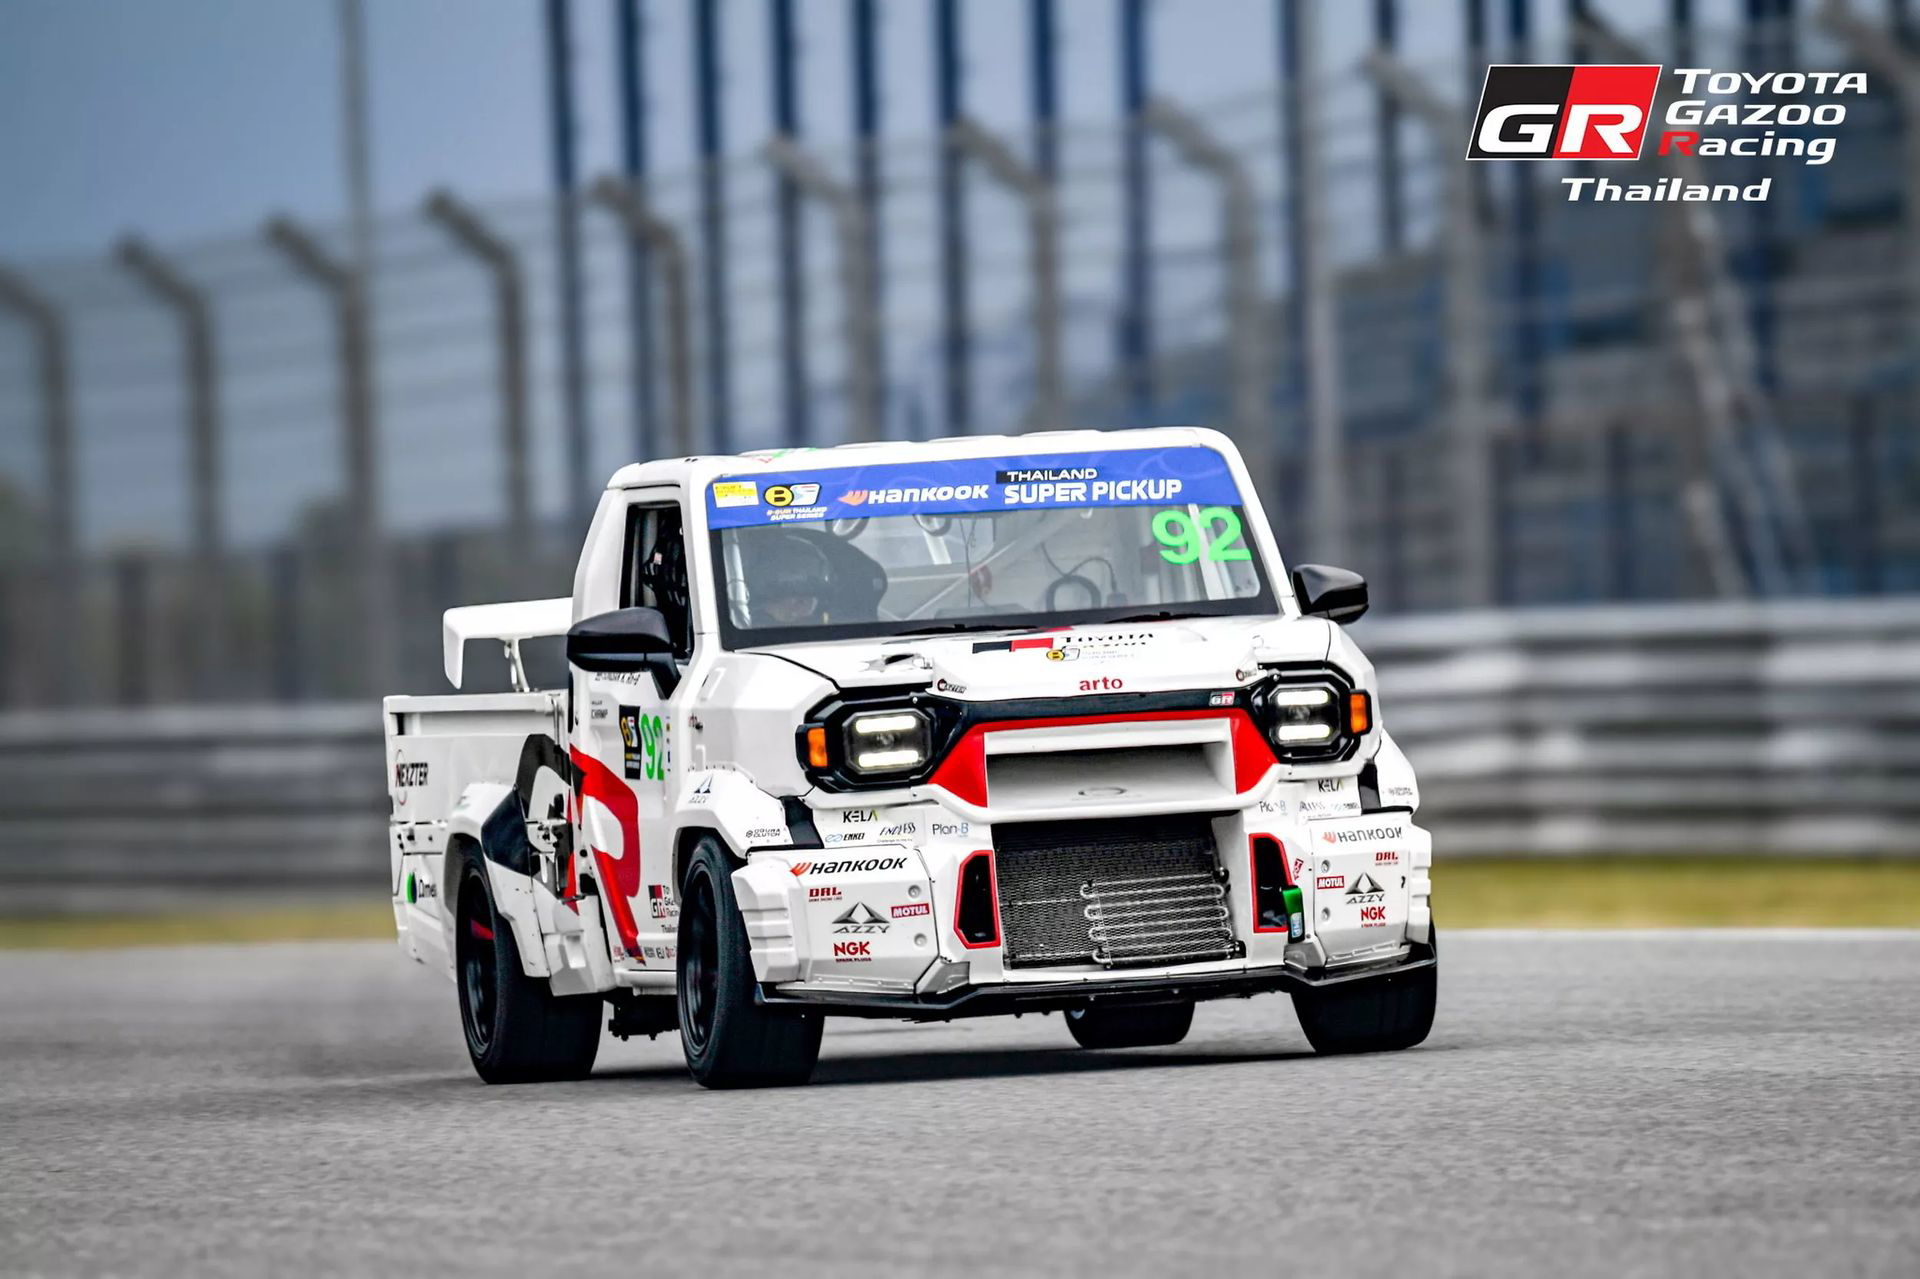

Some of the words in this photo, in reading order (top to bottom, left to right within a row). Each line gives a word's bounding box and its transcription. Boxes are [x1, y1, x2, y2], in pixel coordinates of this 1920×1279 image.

[1007, 467, 1098, 482] THAILAND
[1004, 482, 1087, 504] SUPER
[1092, 479, 1182, 501] PICKUP
[1152, 506, 1252, 565] 92
[1079, 676, 1123, 691] arto
[641, 713, 664, 781] 92
[1318, 876, 1344, 888] MOTUL
[1346, 894, 1385, 905] AZZY
[893, 905, 928, 918] MOTUL
[1360, 906, 1386, 921] NGK
[833, 925, 891, 934] AZZY
[833, 941, 871, 956] NGK
